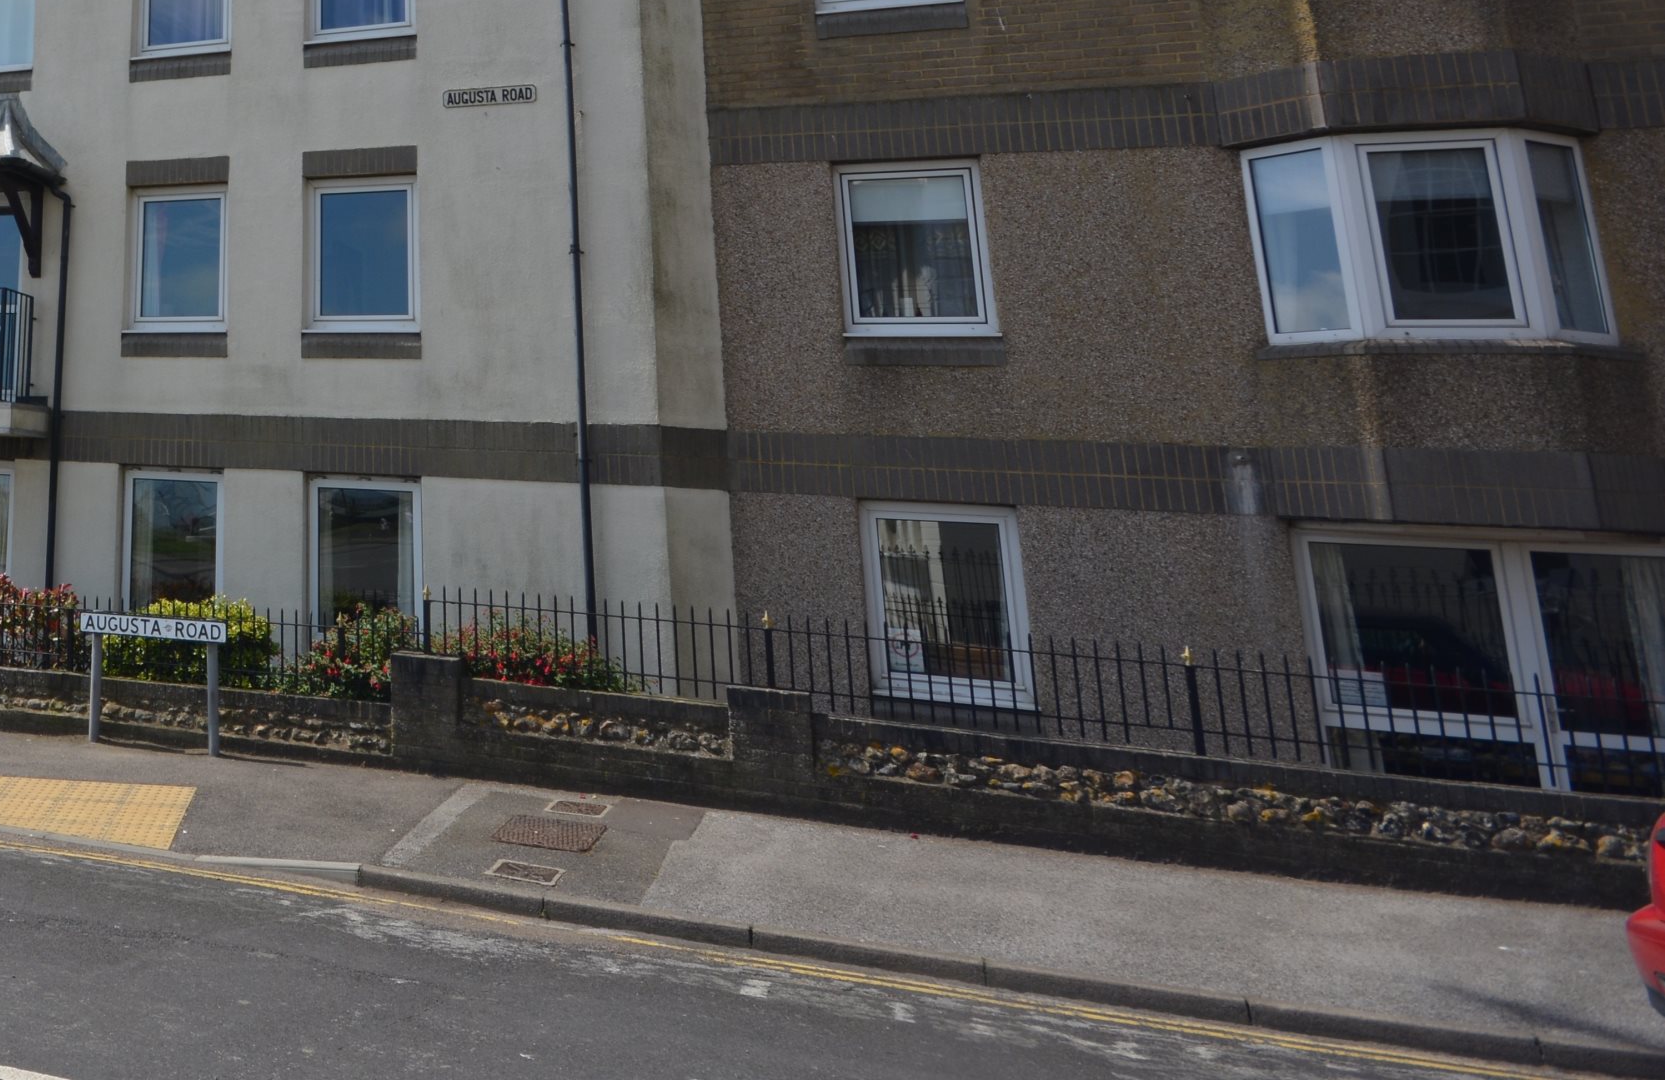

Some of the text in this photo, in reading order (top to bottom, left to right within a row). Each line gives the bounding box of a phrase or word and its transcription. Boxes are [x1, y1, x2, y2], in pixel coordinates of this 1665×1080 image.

[447, 87, 533, 106] AUGUSTA ROAD
[84, 615, 221, 640] AUGUSTA ROAD
